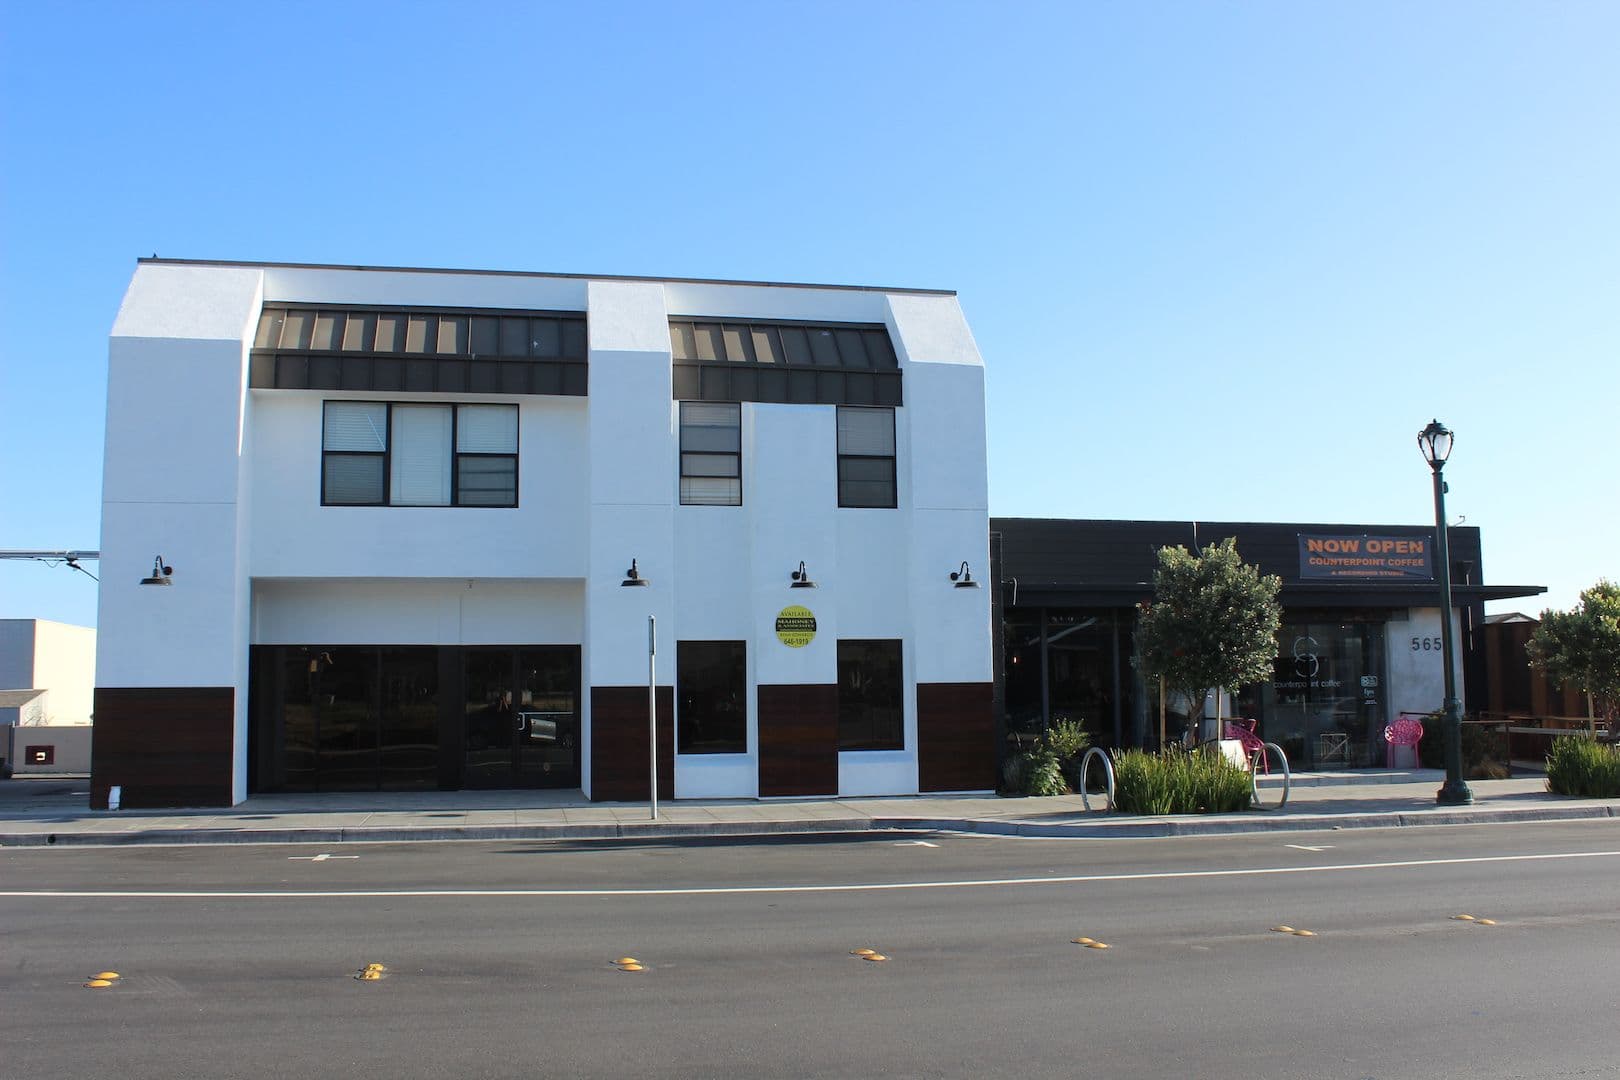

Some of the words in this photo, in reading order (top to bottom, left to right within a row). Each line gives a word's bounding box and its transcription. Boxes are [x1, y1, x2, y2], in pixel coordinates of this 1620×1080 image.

[1308, 539, 1360, 553] NOW
[1366, 540, 1424, 553] OPEN
[1309, 557, 1385, 566] COUNTERPOINT
[1388, 558, 1424, 567] COFFEE
[1412, 637, 1442, 651] 565
